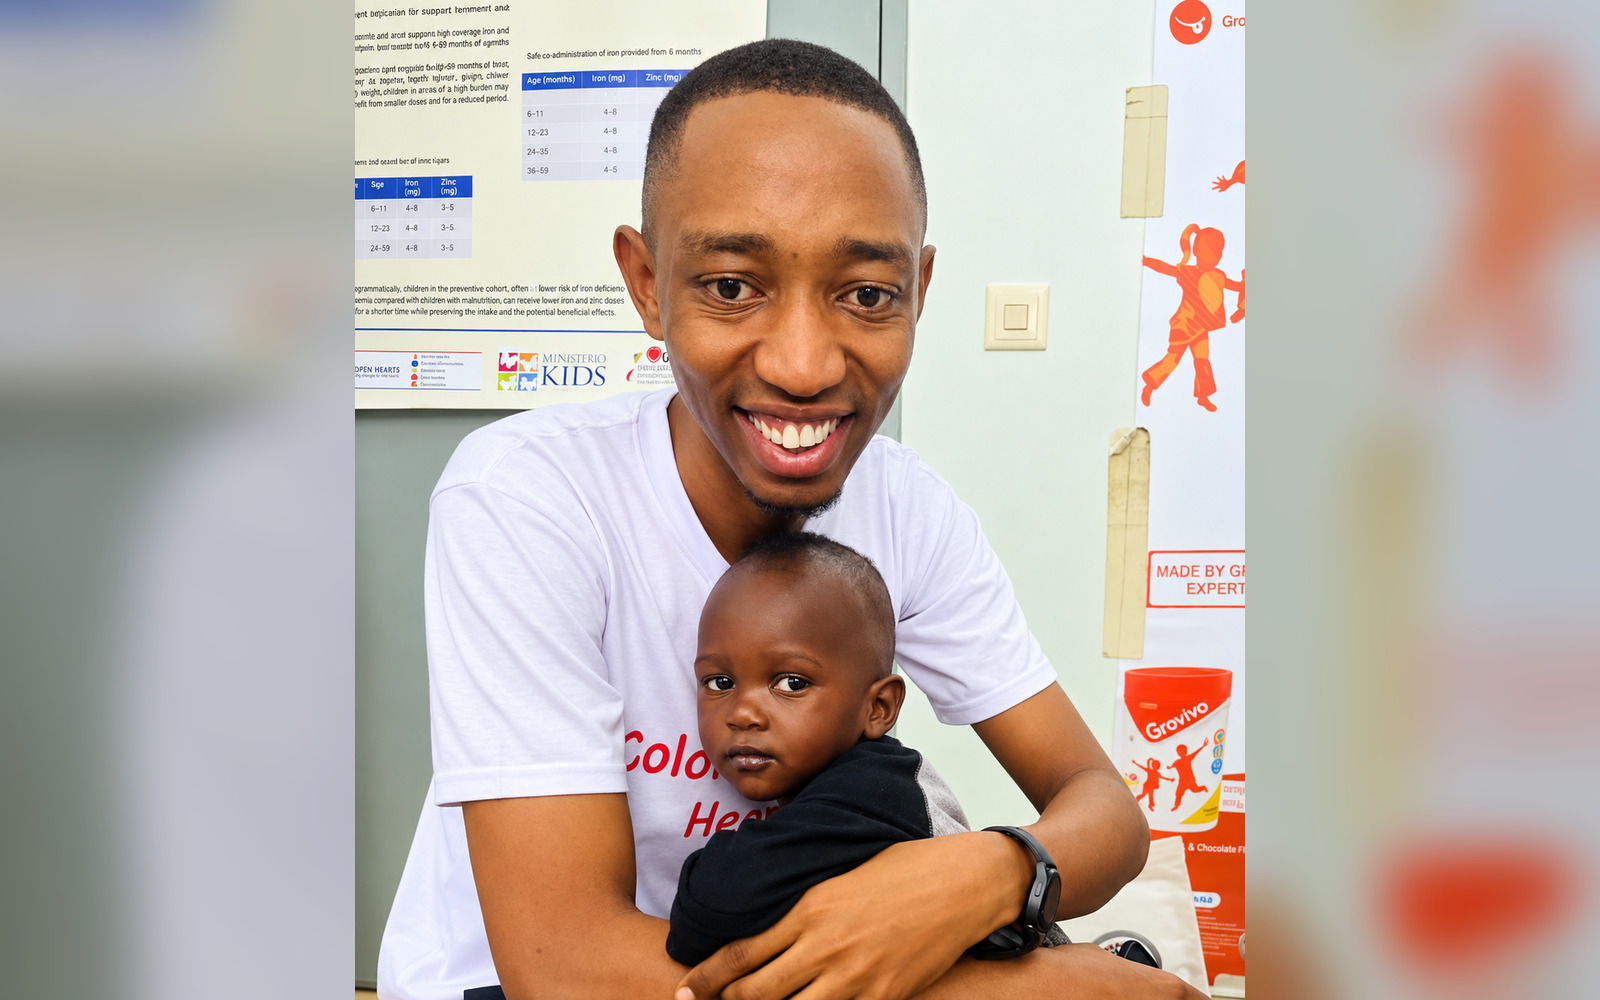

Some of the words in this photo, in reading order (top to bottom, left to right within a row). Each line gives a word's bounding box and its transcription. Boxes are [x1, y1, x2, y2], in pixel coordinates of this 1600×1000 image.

[437, 29, 450, 39] high
[452, 29, 481, 38] coverage
[483, 27, 495, 36] iron
[497, 26, 510, 35] and
[448, 39, 473, 49] months
[474, 39, 481, 48] of
[527, 52, 541, 60] Safe
[542, 50, 598, 60] co-administration
[598, 49, 605, 58] of
[606, 49, 620, 57] iron
[621, 48, 649, 57] provided
[651, 48, 667, 56] from
[669, 48, 674, 56] 6
[675, 48, 702, 56] months
[457, 61, 483, 70] months
[527, 76, 542, 85] Age
[543, 75, 576, 85] (months)
[592, 74, 607, 83] Iron
[608, 74, 626, 84] (mg)
[646, 73, 662, 82] Zinc
[664, 73, 682, 83] (mg)
[383, 87, 409, 96] children
[410, 86, 417, 95] in
[418, 86, 437, 94] areas
[438, 85, 445, 93] of
[453, 84, 468, 94] high
[469, 84, 493, 92] burden
[494, 84, 509, 93] may
[368, 99, 383, 108] from
[384, 98, 408, 108] smaller
[408, 97, 428, 106] doses
[428, 96, 441, 105] and
[442, 96, 451, 105] for
[458, 95, 485, 104] reduced
[486, 94, 510, 105] period.
[441, 178, 457, 186] Zinc
[404, 187, 420, 196] (mg)
[440, 187, 458, 196] (mg)
[449, 285, 484, 294] preventive
[485, 285, 510, 294] cohort,
[511, 284, 529, 292] often
[538, 284, 557, 292] lower
[571, 284, 579, 292] of
[580, 284, 593, 292] iron
[374, 297, 405, 306] compared
[461, 297, 502, 306] malnutrition,
[541, 296, 559, 304] lower
[560, 296, 574, 304] iron
[575, 296, 588, 304] and
[589, 296, 603, 304] zinc
[604, 297, 624, 305] doses
[370, 307, 394, 315] shorter
[394, 307, 410, 315] time
[410, 307, 428, 315] while
[429, 308, 463, 317] preserving
[498, 308, 512, 316] and
[526, 308, 556, 317] potential
[557, 308, 590, 316] beneficial
[591, 308, 617, 316] effects.
[542, 353, 607, 364] MINISTERIO
[355, 365, 373, 373] OPEN
[374, 366, 400, 374] HEARTS
[541, 365, 607, 387] KIDS
[1157, 564, 1201, 578] MADE
[1205, 564, 1225, 578] BY
[1187, 582, 1245, 595] EXPERT
[1145, 702, 1209, 740] Grovivo
[625, 730, 719, 780] Colo
[1188, 842, 1195, 852] &
[1197, 843, 1237, 854] Chocolate
